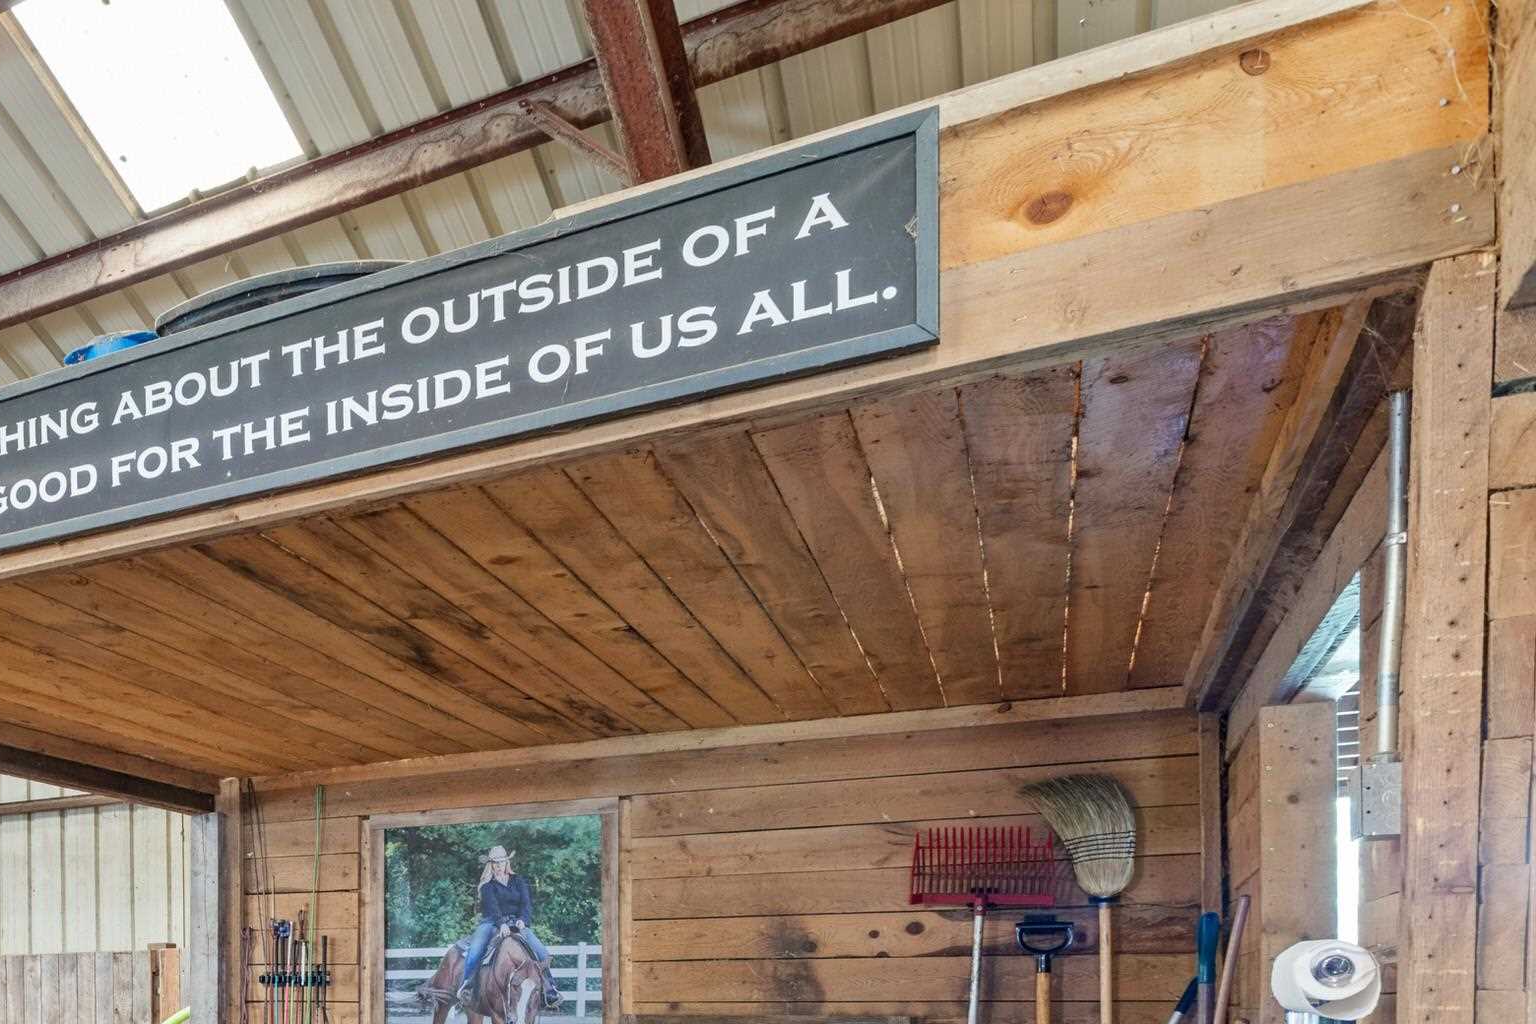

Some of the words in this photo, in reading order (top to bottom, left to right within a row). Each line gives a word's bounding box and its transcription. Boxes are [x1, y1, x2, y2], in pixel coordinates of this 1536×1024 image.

[109, 436, 202, 488] FOR
[211, 405, 311, 461] THE
[325, 354, 511, 436] INSIDE
[527, 327, 612, 384] OF
[629, 305, 719, 359] US
[736, 268, 898, 336] ALL.
[111, 349, 271, 426] ABOUT
[281, 316, 386, 377] THE
[401, 237, 663, 345] OUTSIDE
[682, 205, 776, 268] OF
[793, 191, 850, 241] A
